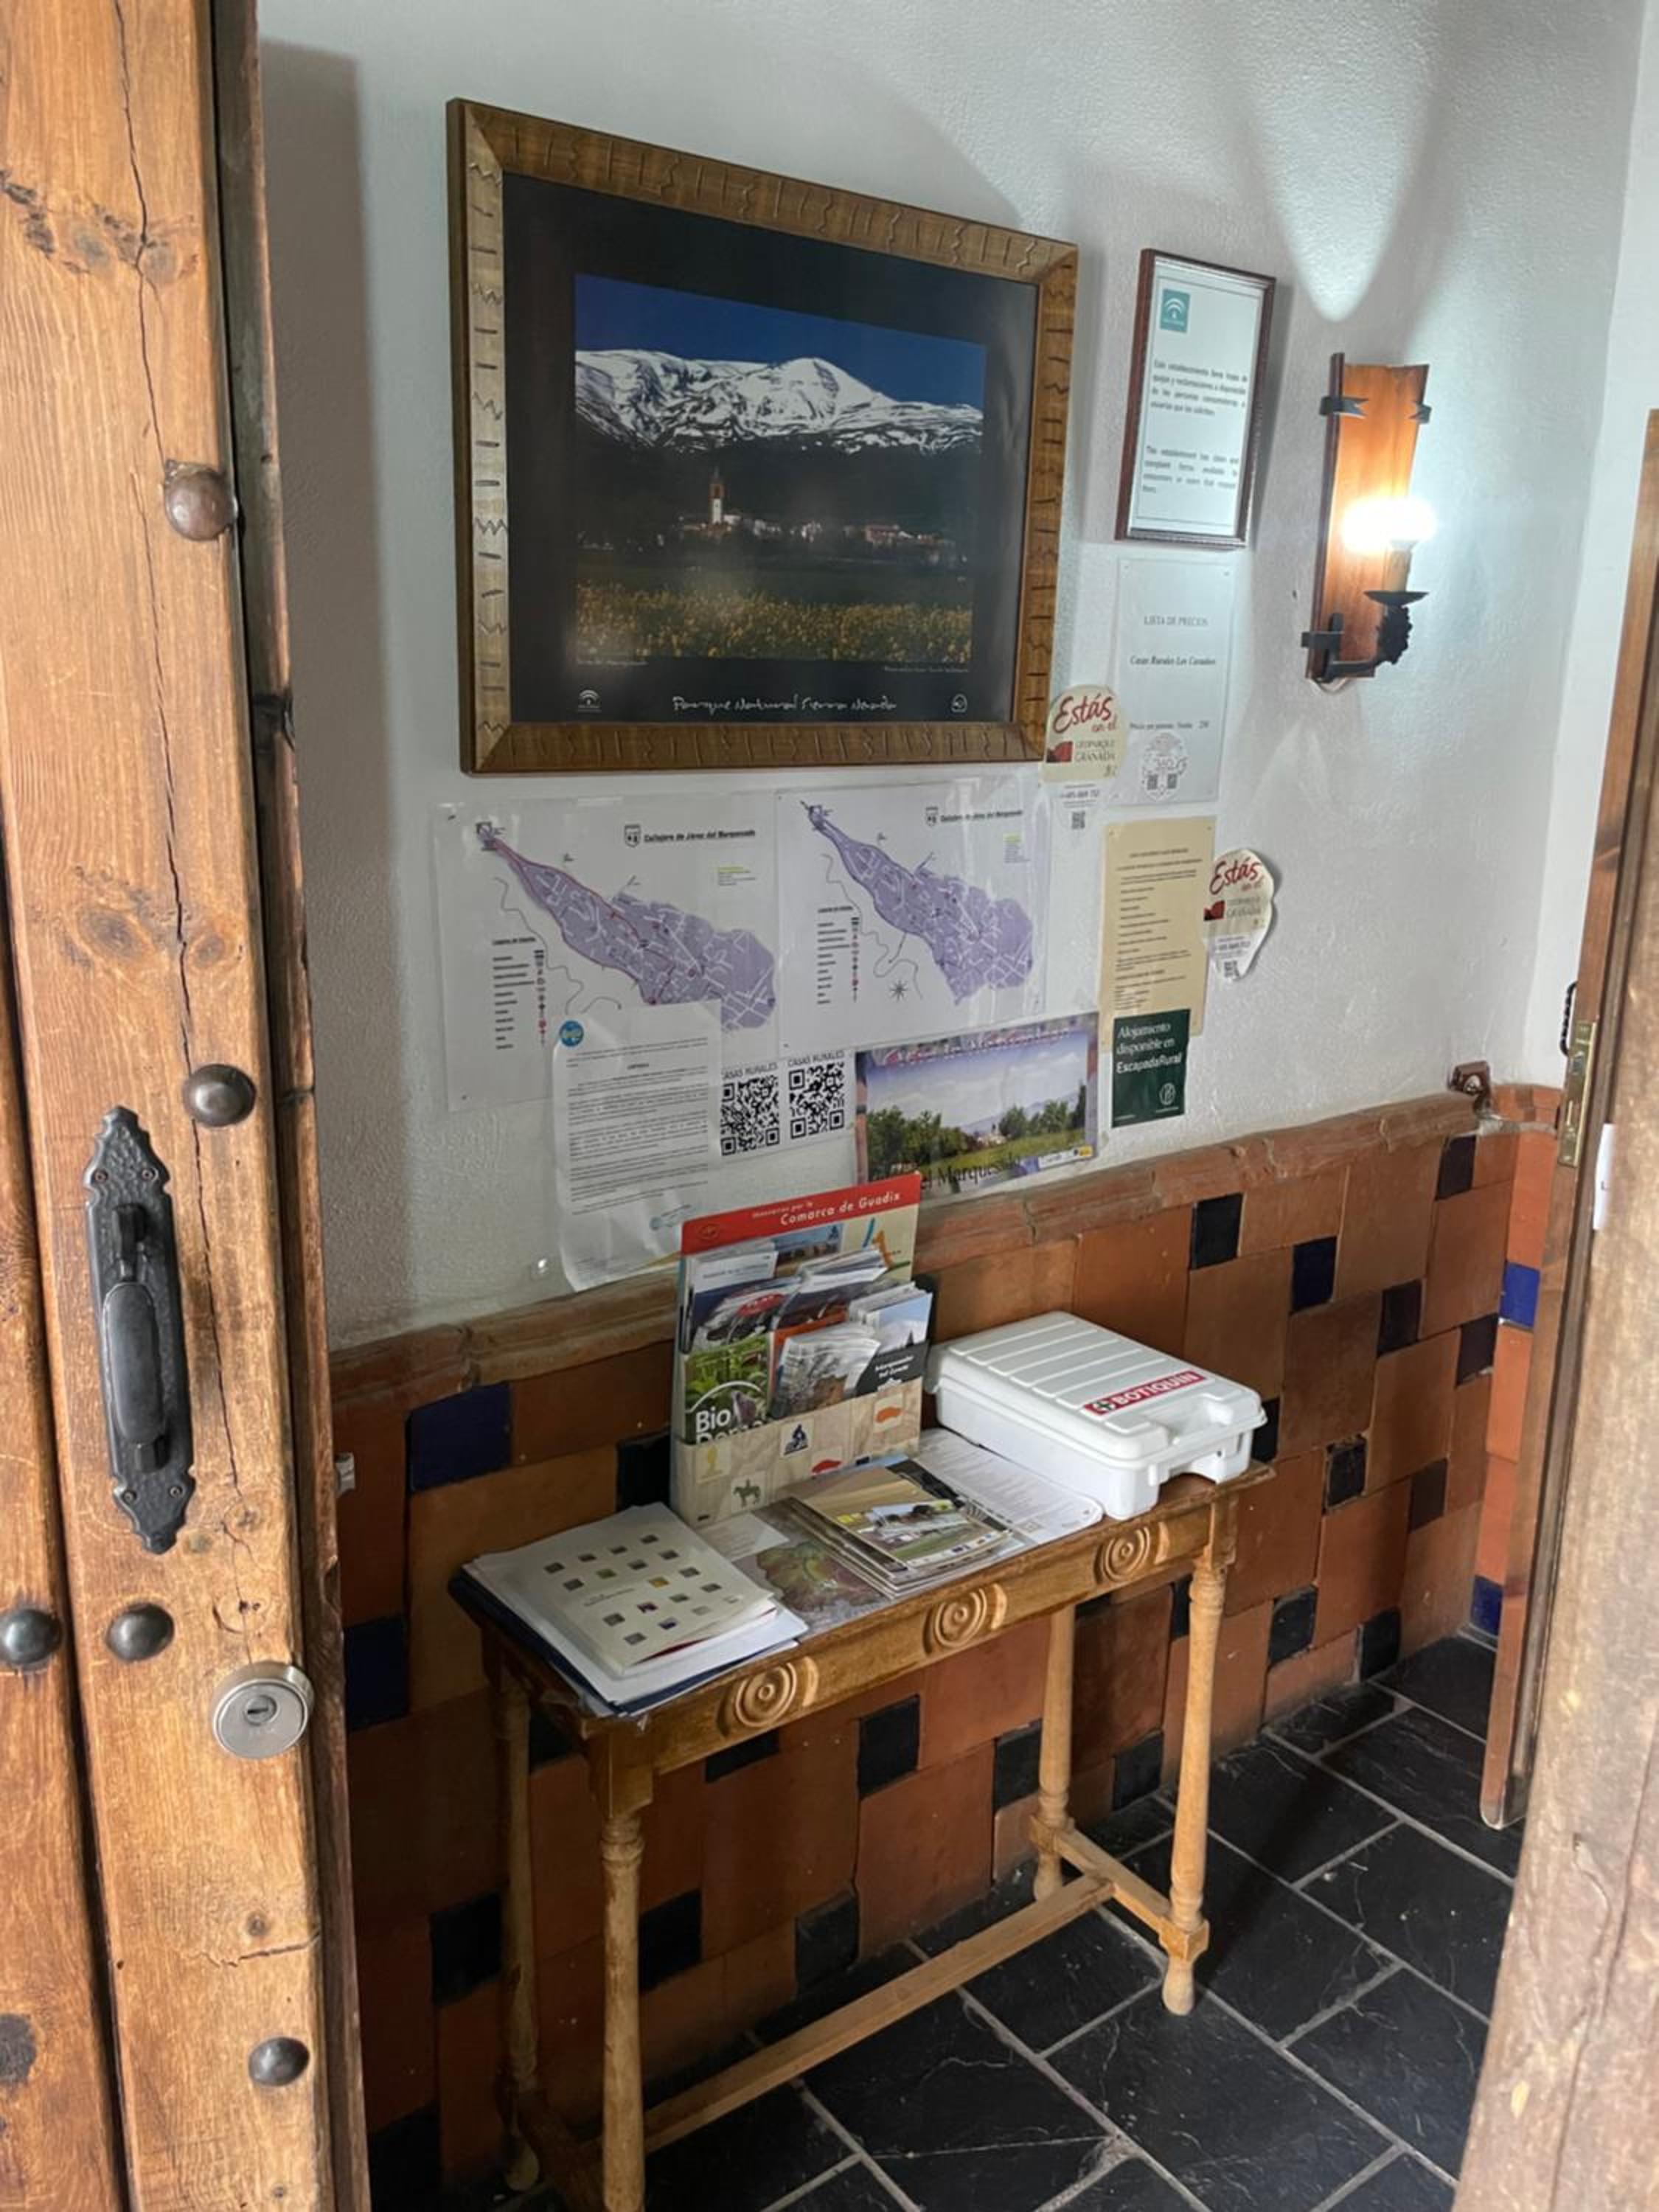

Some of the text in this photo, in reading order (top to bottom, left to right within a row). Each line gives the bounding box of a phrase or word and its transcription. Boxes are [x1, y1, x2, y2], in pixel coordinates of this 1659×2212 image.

[1053, 692, 1112, 734] Estás
[1209, 856, 1262, 895] Estás
[1117, 1023, 1172, 1040] Alojamiento
[787, 1057, 810, 1067] CASAS
[780, 1191, 900, 1225] Comarca de Guadix
[696, 1406, 731, 1433] Bio
